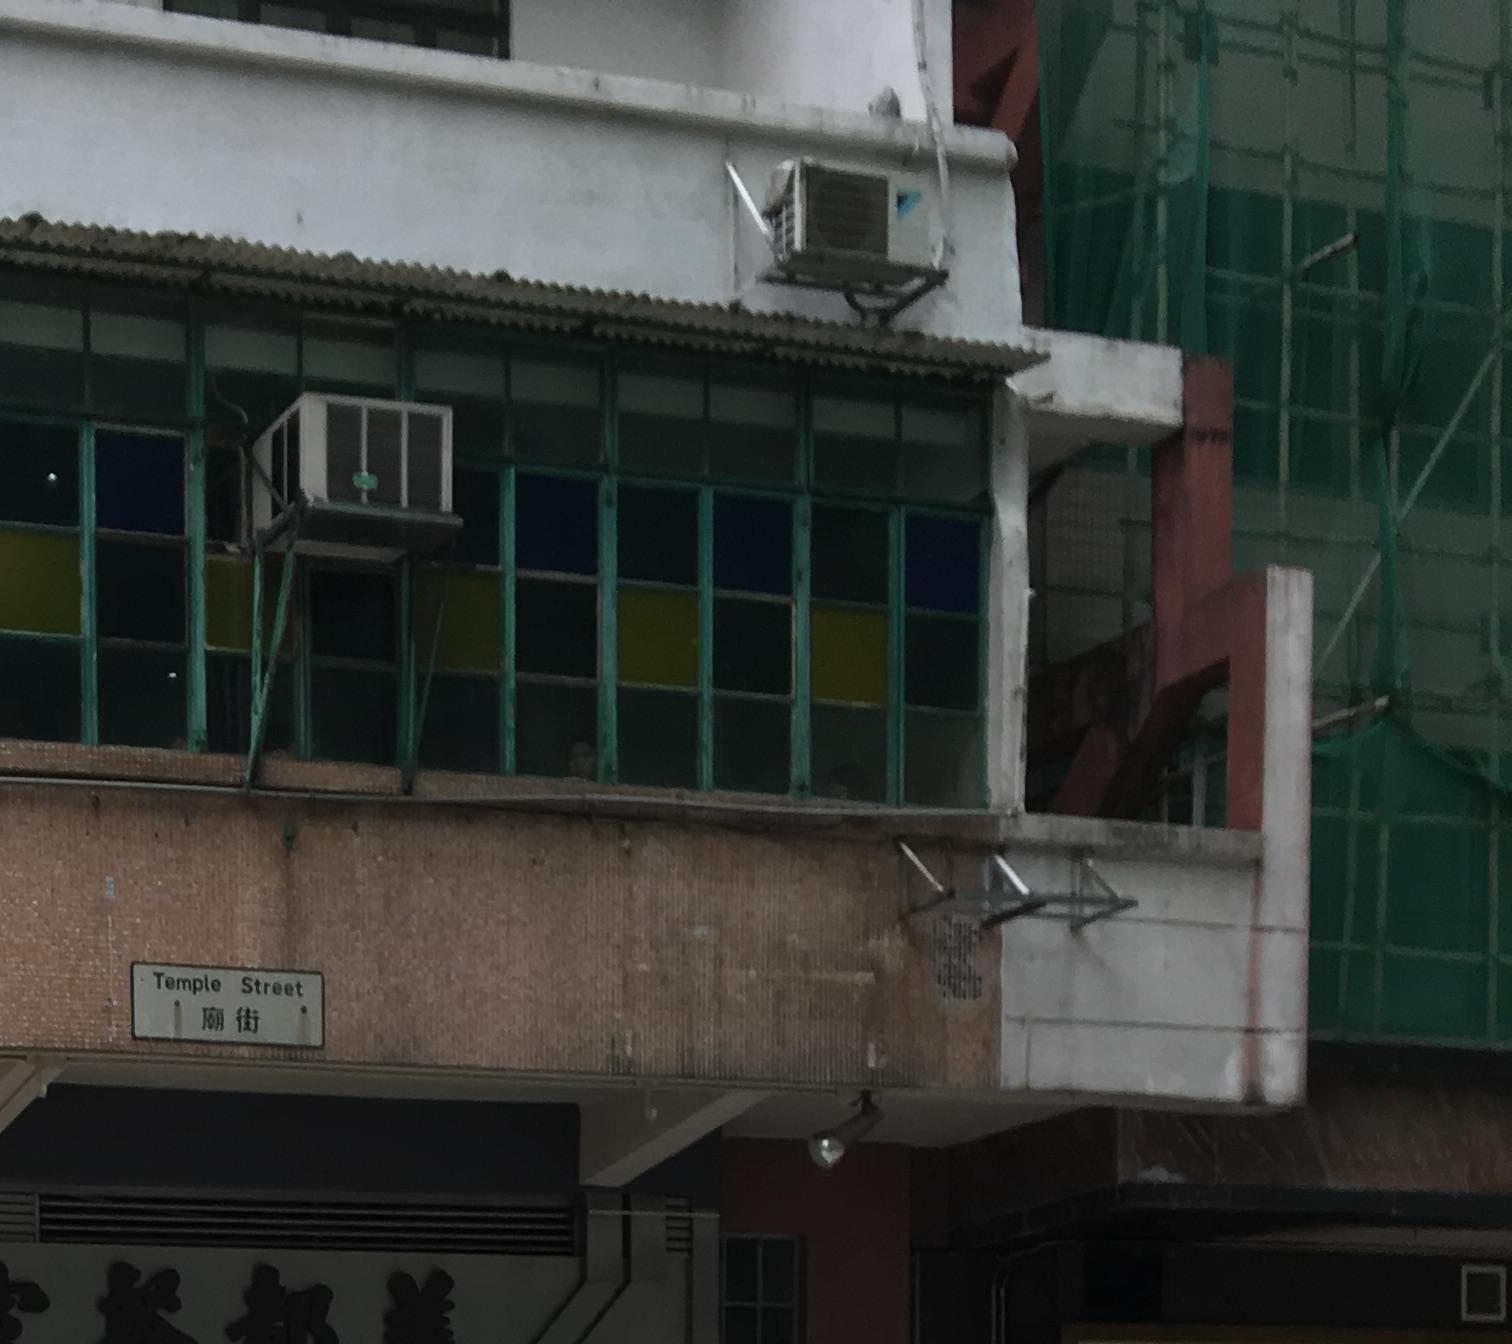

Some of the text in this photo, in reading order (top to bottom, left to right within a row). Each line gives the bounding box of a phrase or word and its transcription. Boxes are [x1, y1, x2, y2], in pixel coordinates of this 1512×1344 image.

[152, 971, 304, 998] Temple Street
[201, 1006, 261, 1033] 廟街
